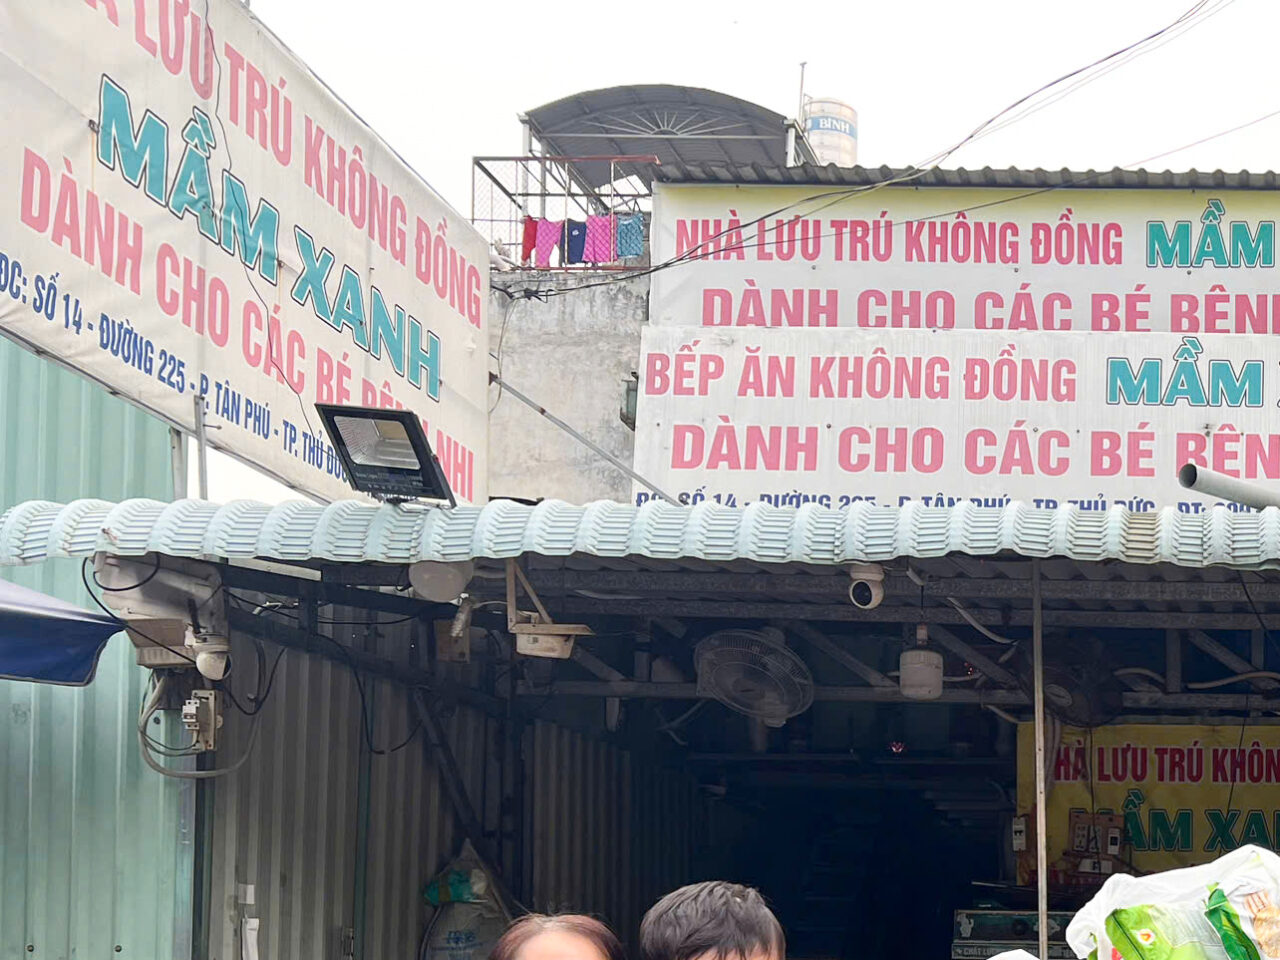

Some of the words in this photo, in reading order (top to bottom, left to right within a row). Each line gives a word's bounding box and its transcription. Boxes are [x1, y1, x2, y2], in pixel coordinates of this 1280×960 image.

[225, 41, 292, 167] TRÚ
[304, 114, 407, 266] KHÔNG
[414, 216, 481, 329] ĐỒNG
[97, 73, 280, 286] MẦM
[291, 225, 441, 402] XANH
[676, 209, 745, 261] NHÀ
[757, 214, 822, 262] LƯU
[830, 210, 893, 262] TRÚ
[905, 211, 1020, 264] KHÔNG
[1031, 208, 1123, 265] ĐỒNG
[1146, 199, 1276, 268] MẦM
[20, 147, 143, 296] DÀNH
[156, 243, 230, 348] CHO
[242, 300, 305, 395] CÁC
[317, 347, 351, 406] BÉ
[702, 279, 838, 328] DÀNH
[857, 289, 956, 330] CHO
[974, 283, 1072, 331] CÁC
[1091, 284, 1151, 333] BÉ
[33, 272, 59, 321] SỐ
[63, 293, 82, 335] 14
[99, 313, 154, 376] ĐƯỜNG
[157, 349, 185, 394] 225
[215, 380, 241, 426] TÂN
[244, 400, 271, 440] PHÚ
[283, 420, 298, 457] TP.
[302, 430, 324, 470] THỦ
[645, 340, 724, 396] BẾP
[737, 345, 795, 398] ĂN
[810, 346, 950, 400] KHÔNG
[964, 343, 1077, 402] ĐỒNG
[1106, 336, 1264, 408] MẦM
[436, 429, 473, 503] NHI
[670, 415, 818, 473] DÀNH
[838, 425, 944, 474] CHO
[965, 419, 1071, 477] CÁC
[1091, 422, 1156, 478] BÉ
[1054, 740, 1089, 781] HÀ
[1097, 743, 1149, 783] LƯU
[1155, 740, 1203, 783] TRÚ
